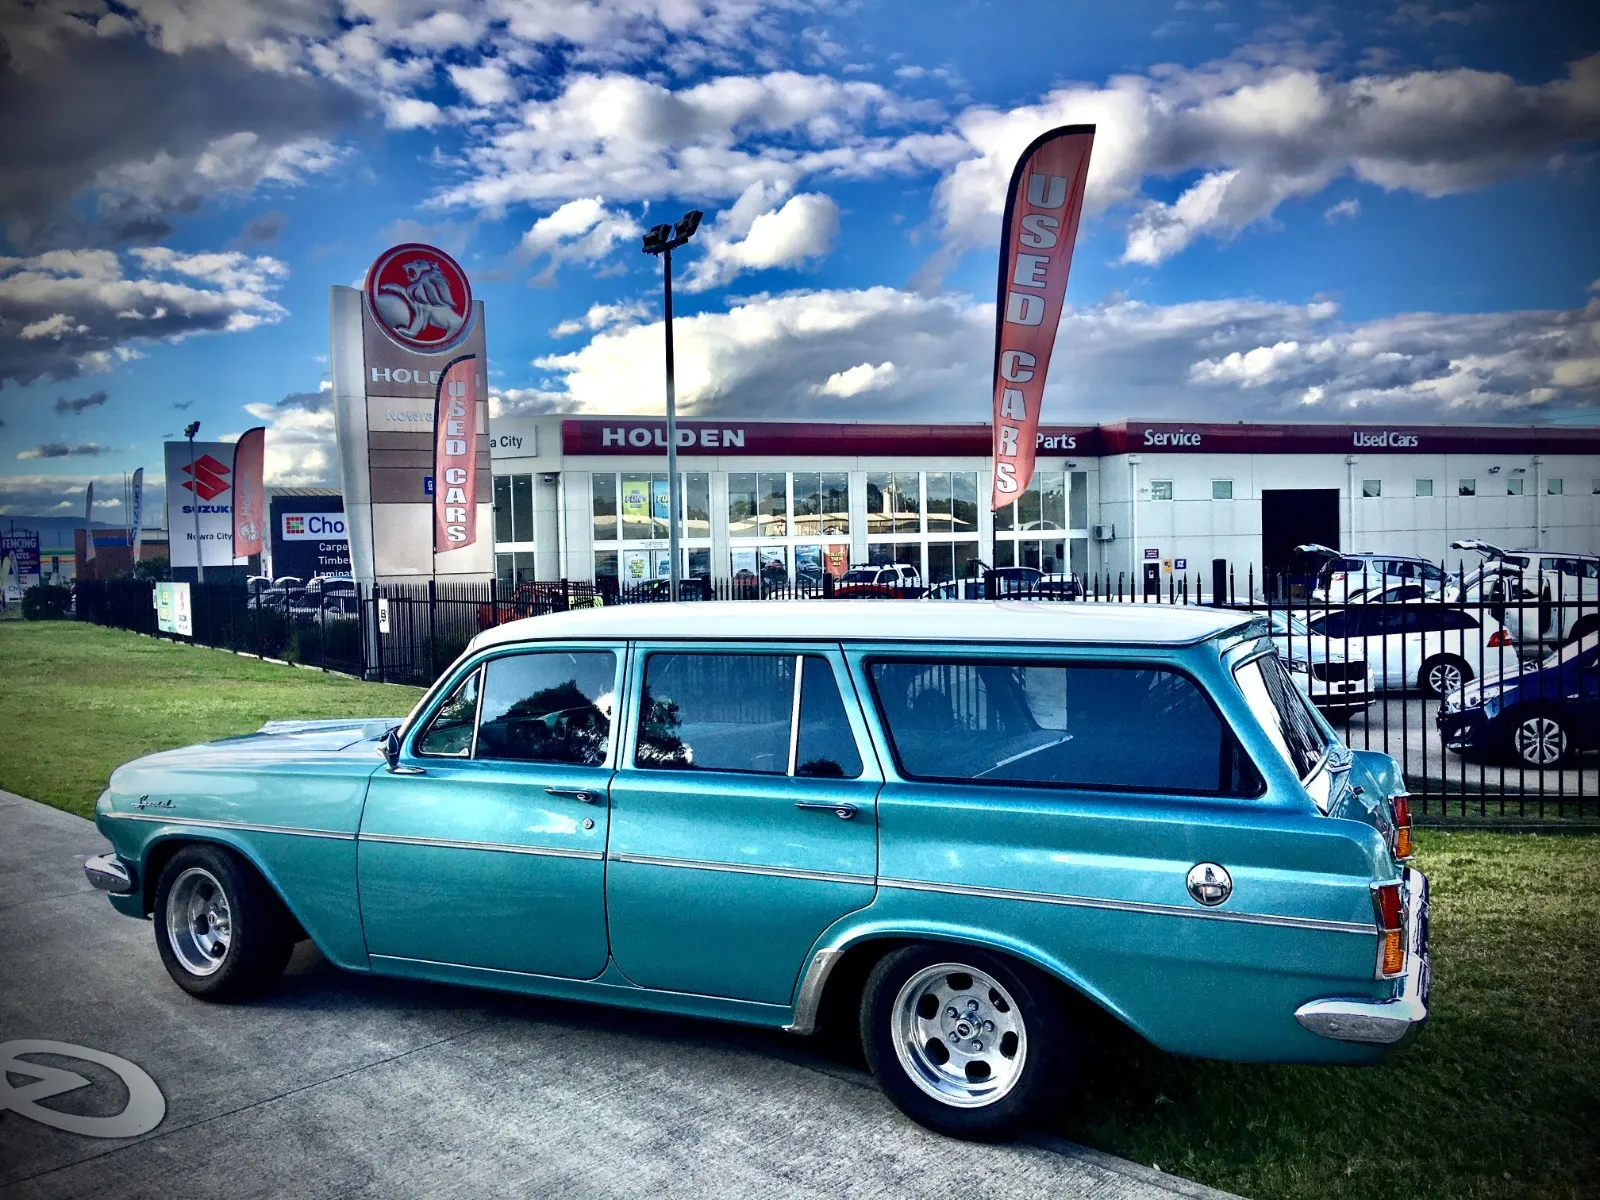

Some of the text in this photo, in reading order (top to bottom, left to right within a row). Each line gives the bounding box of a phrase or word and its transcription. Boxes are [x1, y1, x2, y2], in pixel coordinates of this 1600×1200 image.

[996, 172, 1068, 494] USED CARS
[500, 435, 523, 449] City
[602, 427, 745, 448] HOLDEN
[1035, 432, 1077, 449] Parts
[1143, 428, 1202, 447] Service
[1353, 431, 1419, 447] Used Cars
[445, 380, 468, 542] USED CARS
[308, 516, 347, 534] Cho
[2, 538, 37, 549] FENCING
[216, 532, 233, 541] City
